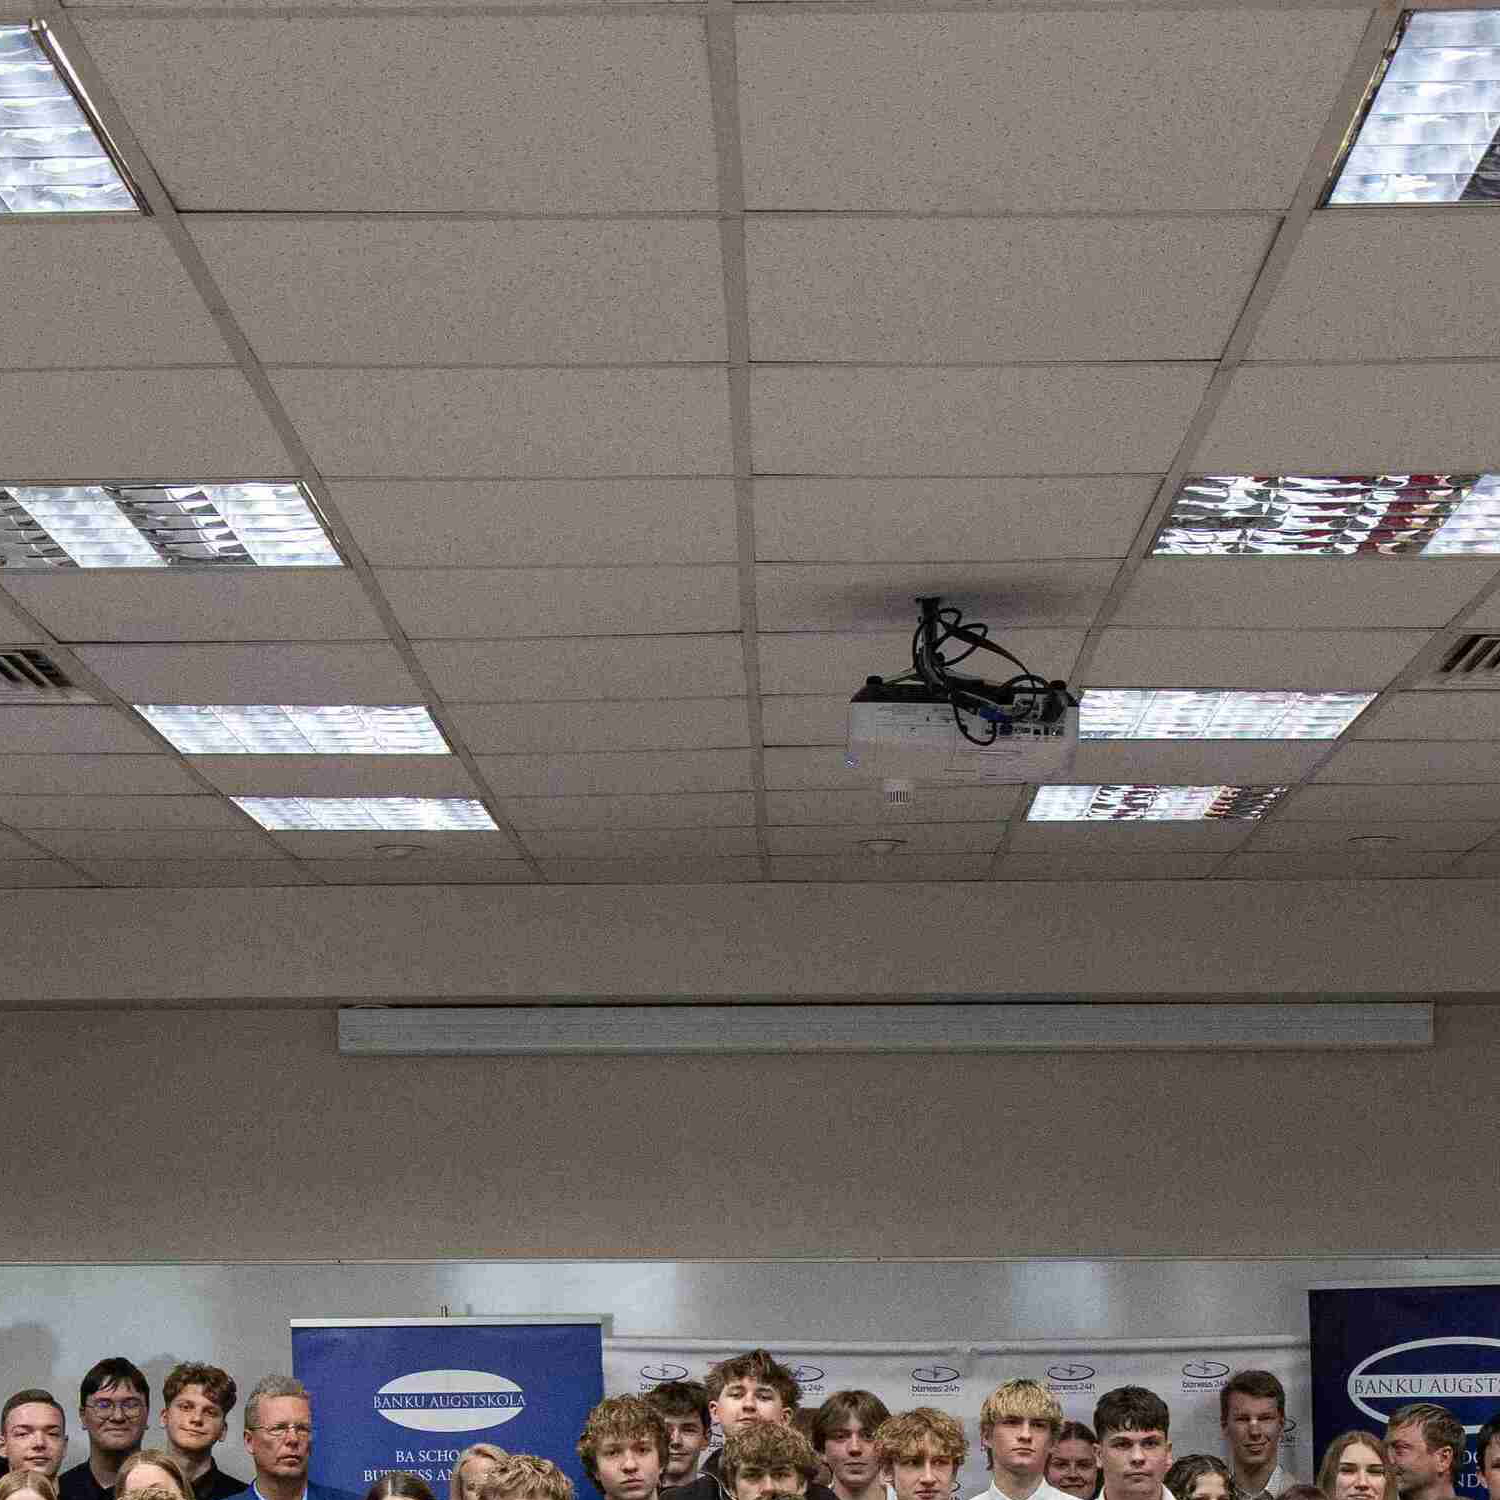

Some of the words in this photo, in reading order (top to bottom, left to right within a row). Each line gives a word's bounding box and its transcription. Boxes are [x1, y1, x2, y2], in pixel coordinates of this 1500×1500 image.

[1354, 1379, 1423, 1394] BANKU
[373, 1395, 425, 1409] BANKU
[430, 1393, 527, 1408] AUGSTSKOLA
[396, 1450, 415, 1463] BA
[419, 1450, 461, 1463] SCHO
